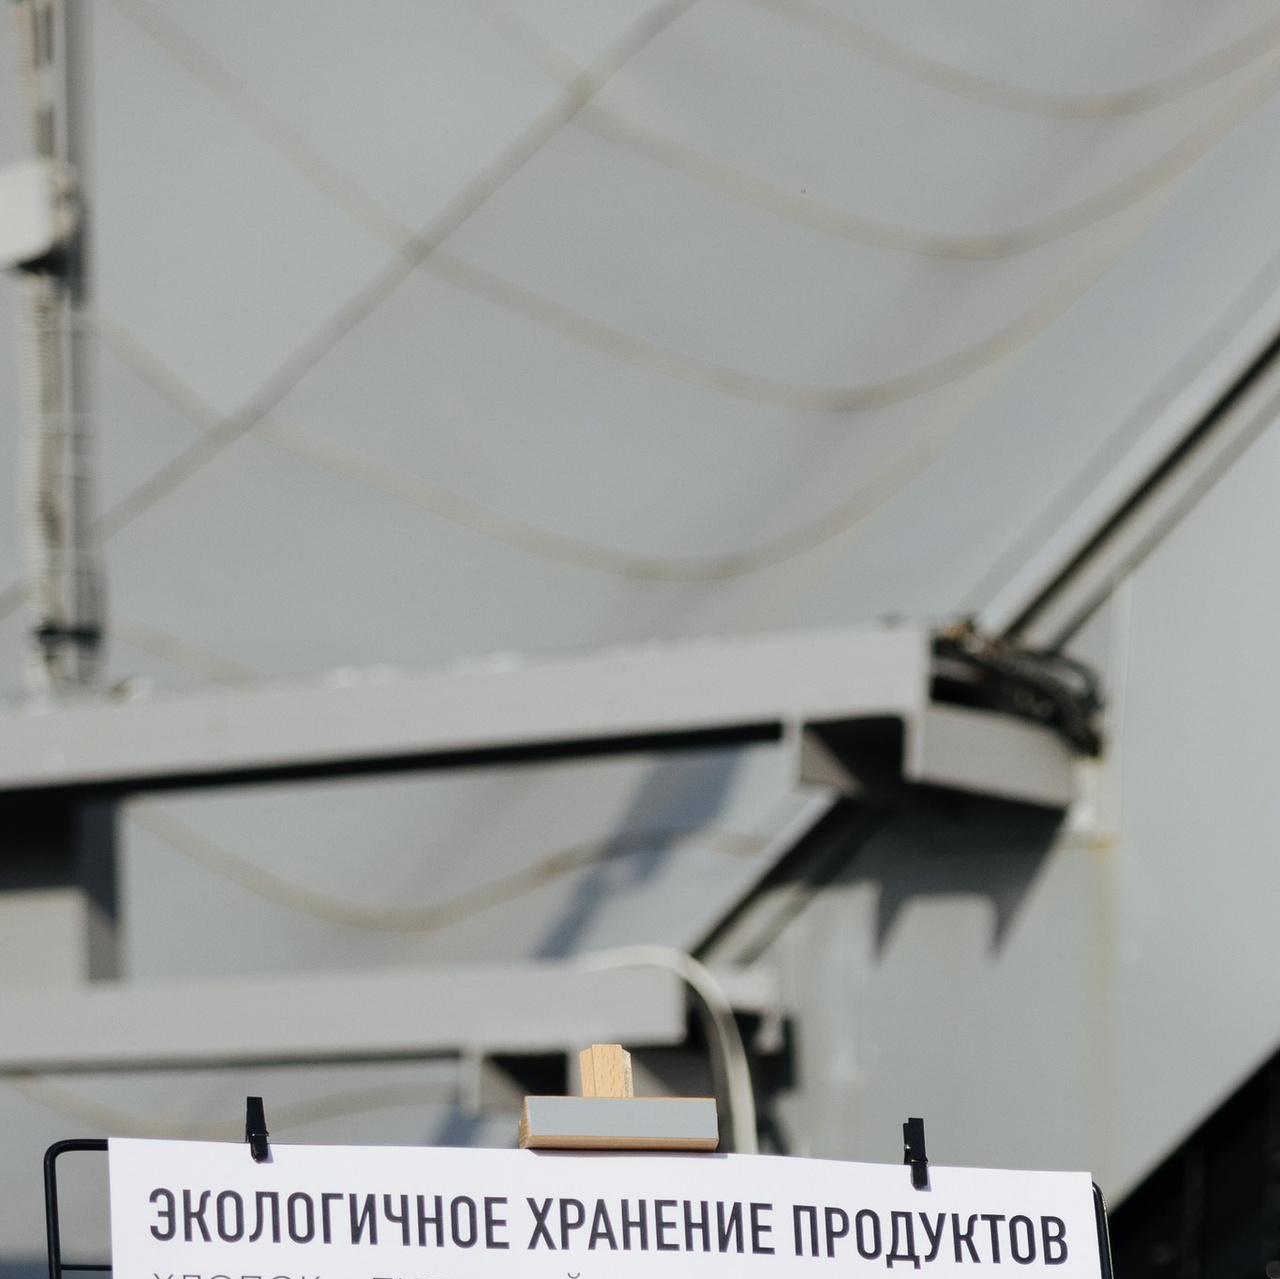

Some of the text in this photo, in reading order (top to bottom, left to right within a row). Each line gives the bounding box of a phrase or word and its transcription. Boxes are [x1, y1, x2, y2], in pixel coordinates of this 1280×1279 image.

[149, 1188, 1068, 1269] ЭКОЛОГИЧНОЕ ХРАНЕНИЕ ПРОДУКТОВ
